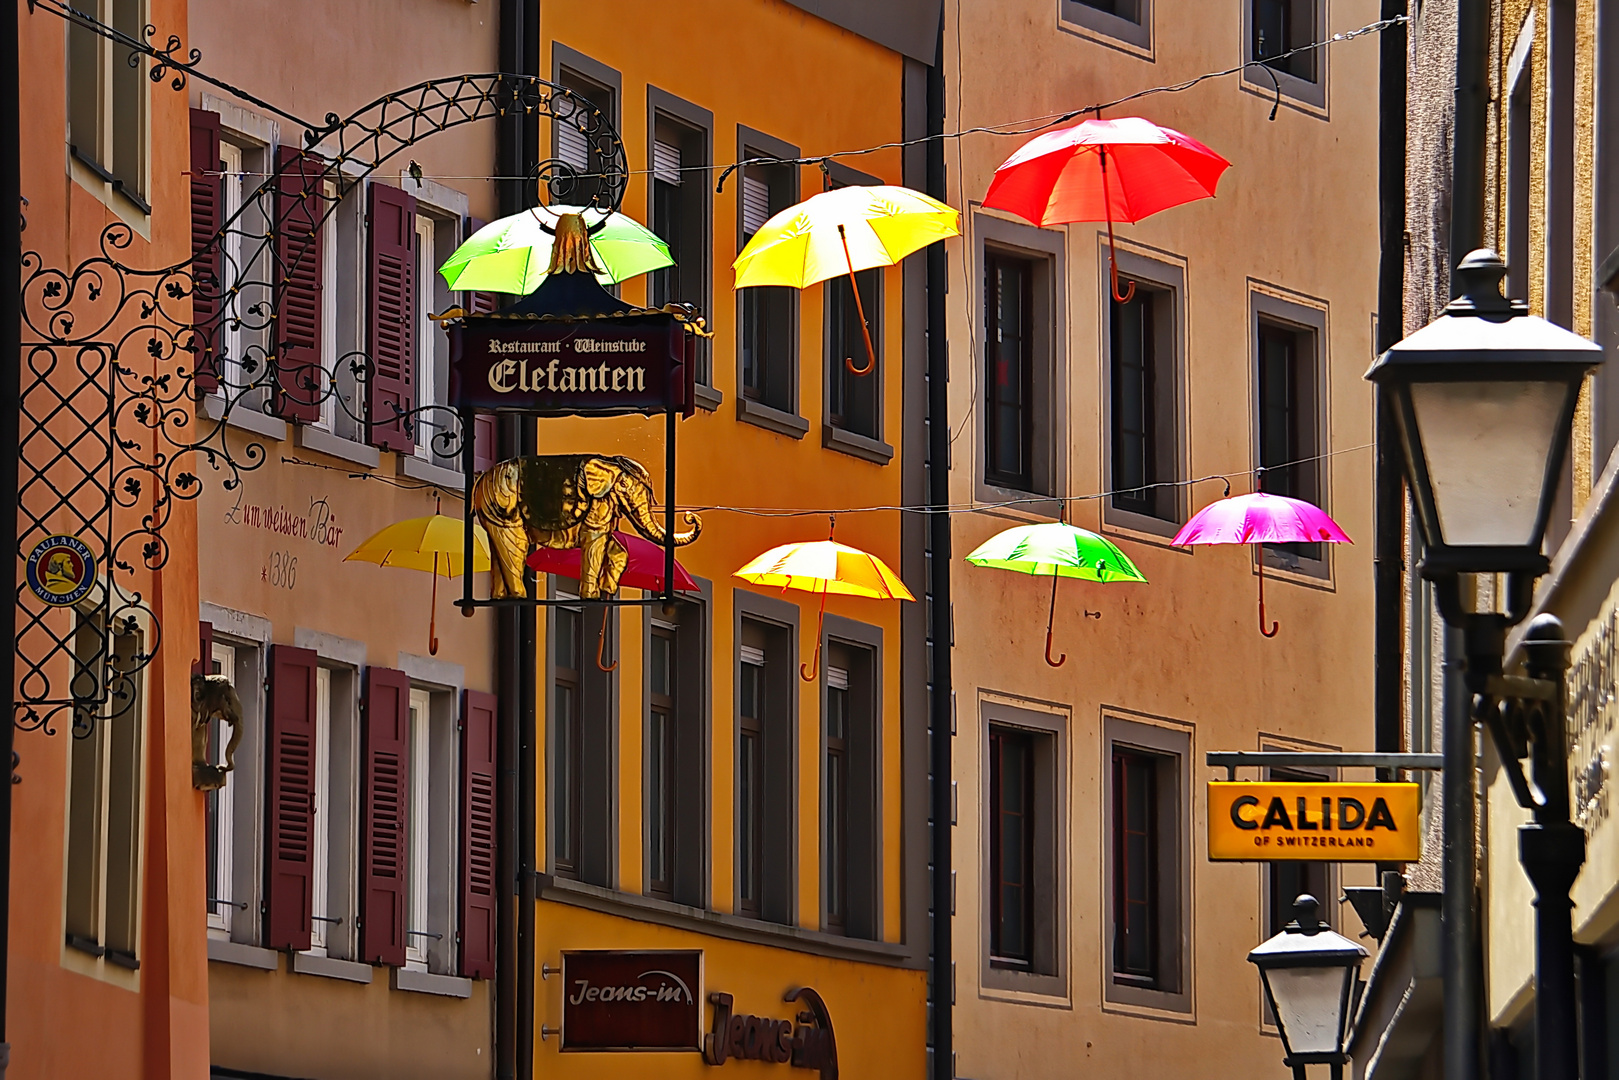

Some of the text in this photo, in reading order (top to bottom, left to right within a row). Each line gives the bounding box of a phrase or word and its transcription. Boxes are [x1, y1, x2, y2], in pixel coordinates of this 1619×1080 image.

[487, 338, 647, 354] Restaurant Weinstube
[487, 358, 646, 393] Elefanten
[224, 479, 343, 549] Zum weissen Bär
[29, 536, 91, 563] PAULANER
[1230, 795, 1398, 831] CALIDA
[1254, 836, 1375, 848] OF SWITZERLAND
[569, 978, 685, 1006] Jeans-in
